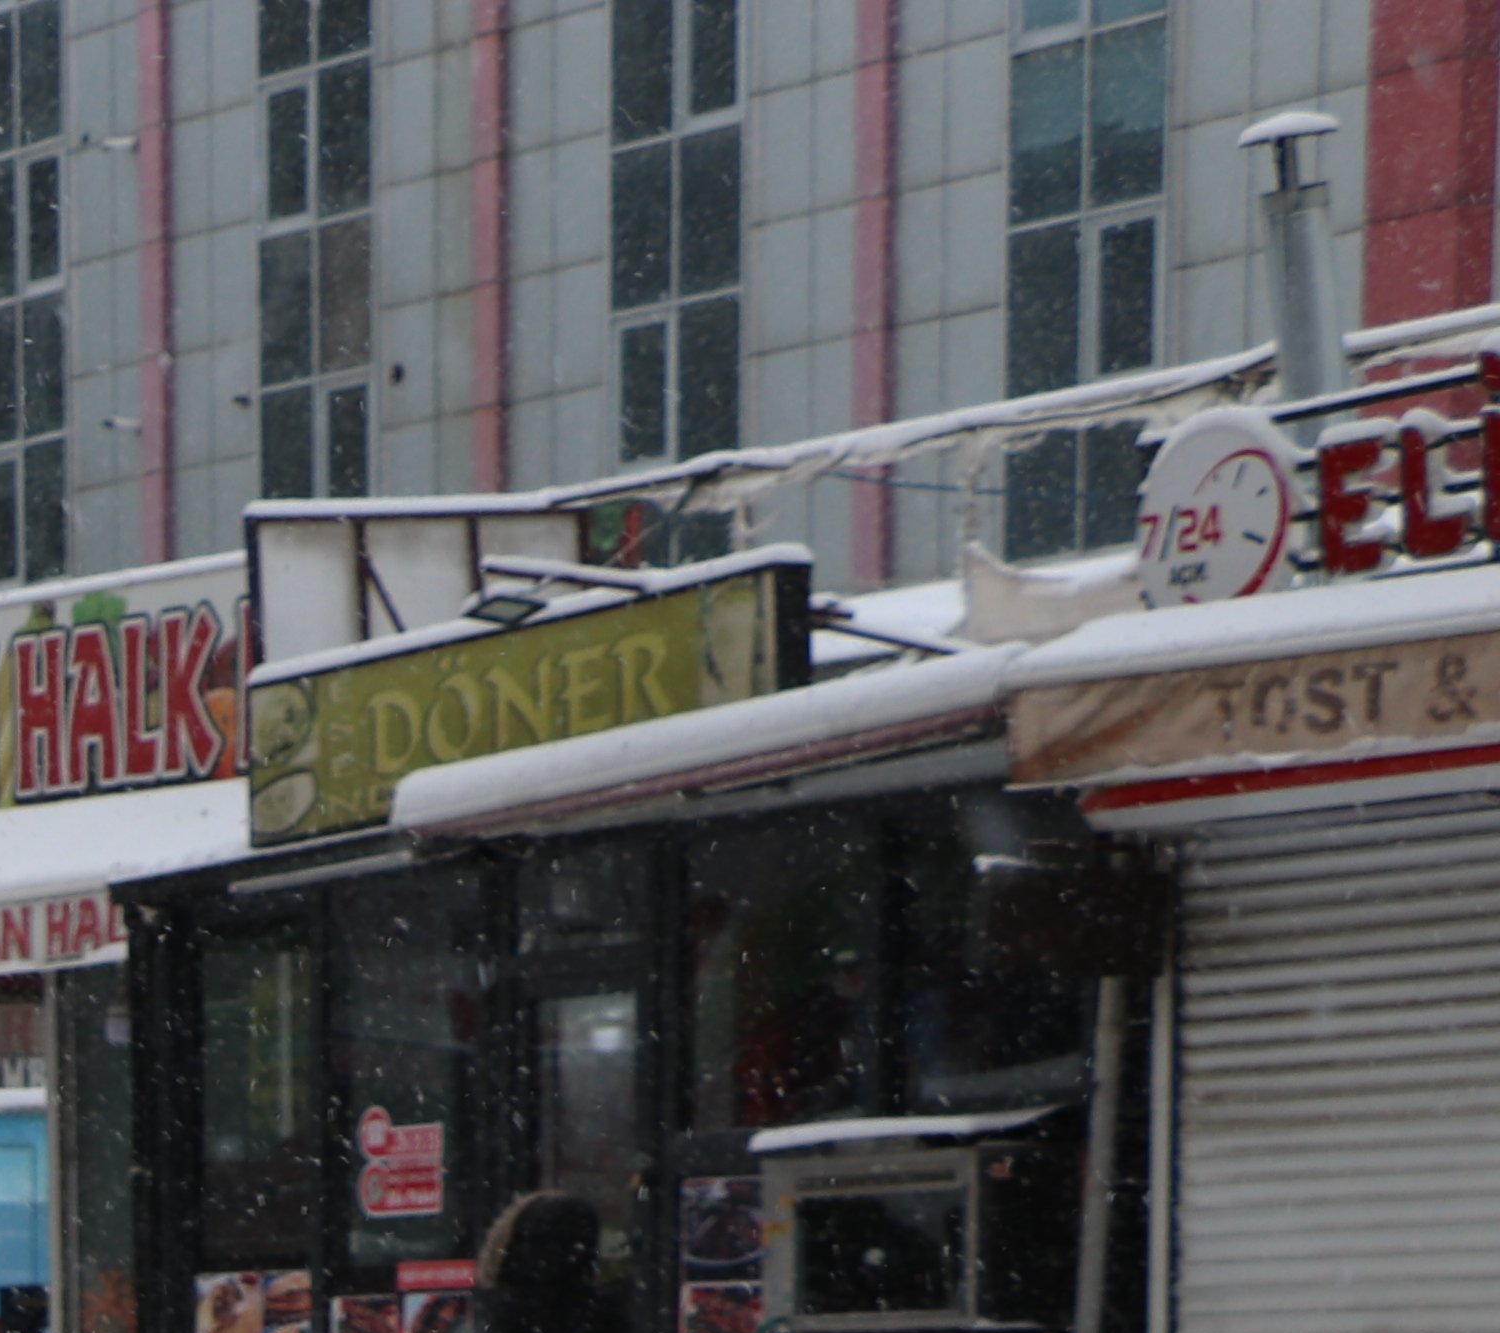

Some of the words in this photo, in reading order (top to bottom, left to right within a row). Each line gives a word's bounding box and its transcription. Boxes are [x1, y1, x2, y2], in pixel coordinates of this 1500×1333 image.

[1139, 504, 1225, 562] 7/24
[14, 600, 223, 799] HALK
[368, 633, 672, 775] DÖNER
[1209, 660, 1398, 742] TOST
